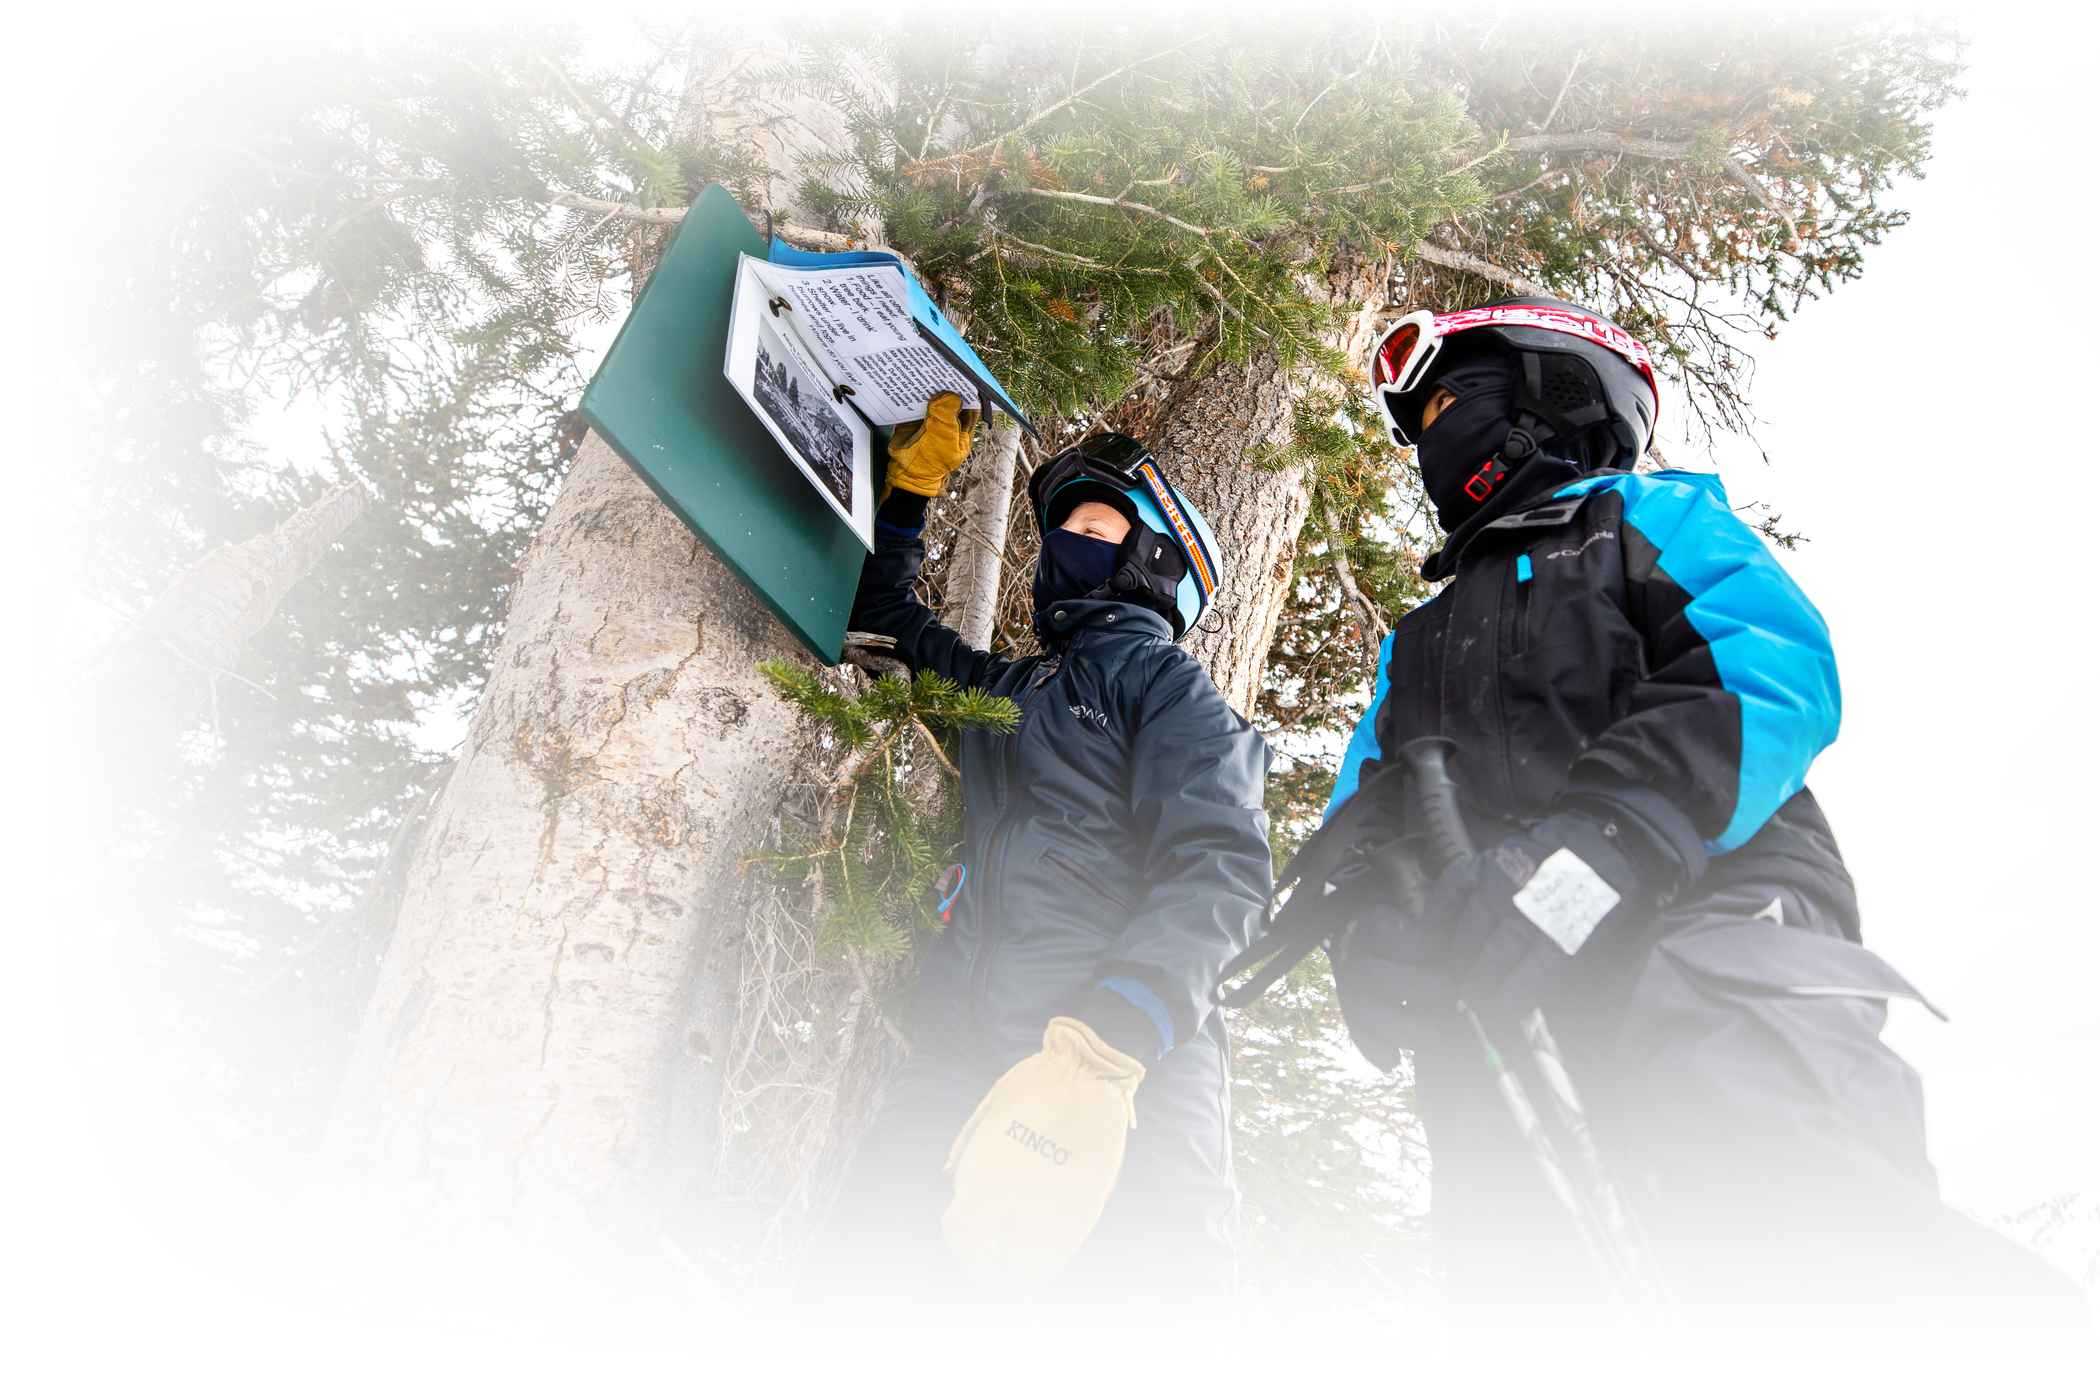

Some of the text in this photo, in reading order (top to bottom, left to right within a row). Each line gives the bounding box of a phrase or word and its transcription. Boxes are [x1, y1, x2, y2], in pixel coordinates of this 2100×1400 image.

[827, 285, 852, 306] Water
[838, 283, 856, 297] tree
[850, 282, 872, 300] Food
[866, 274, 884, 289] Like
[880, 289, 893, 299] all
[804, 287, 834, 314] Shelter
[835, 322, 851, 335] live
[1005, 1119, 1069, 1166] KINCO
